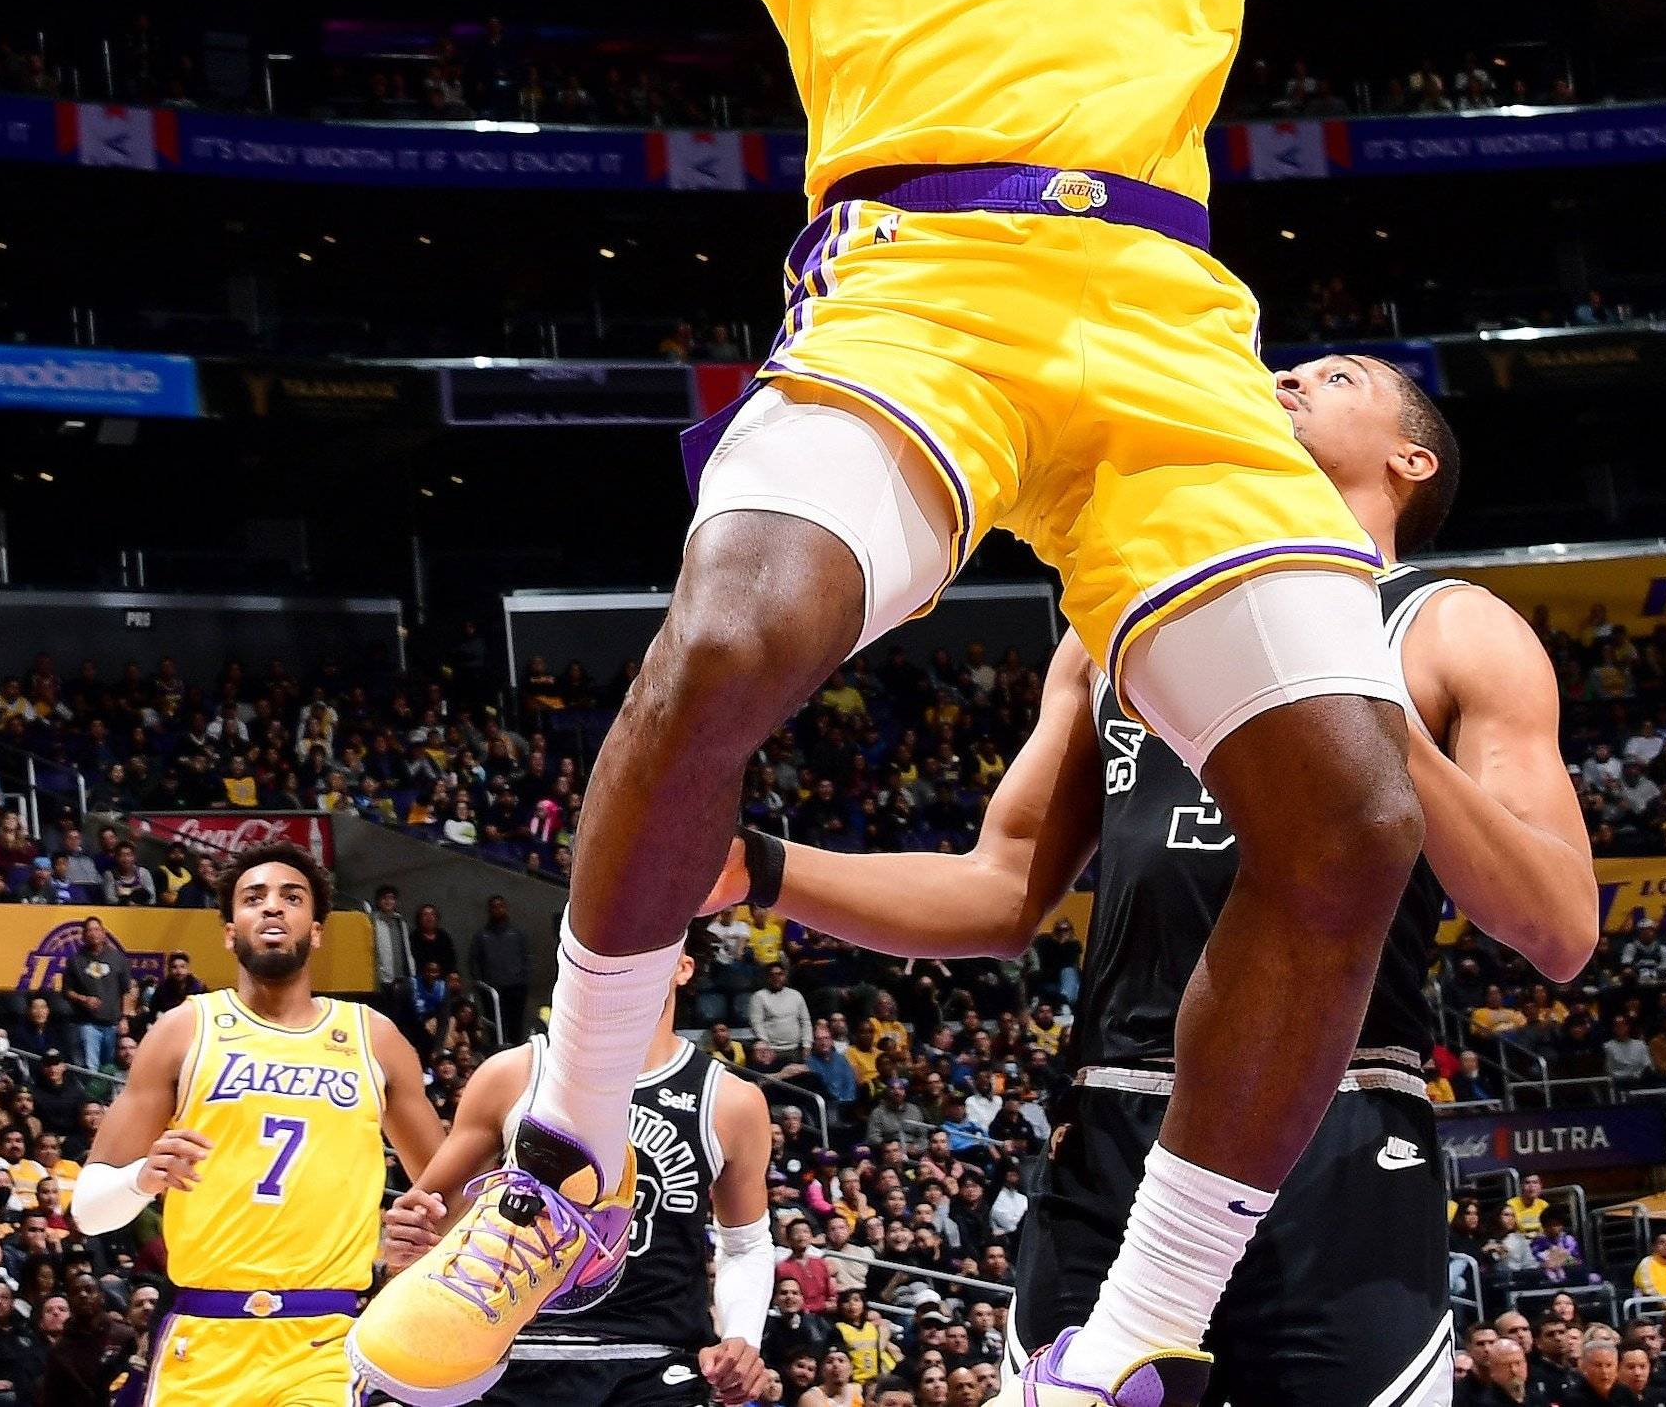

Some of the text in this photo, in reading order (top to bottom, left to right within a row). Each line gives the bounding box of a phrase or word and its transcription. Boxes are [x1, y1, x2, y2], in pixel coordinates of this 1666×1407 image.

[204, 1051, 361, 1109] LAKERS
[254, 1114, 309, 1203] 7
[628, 1103, 700, 1214] TONIO
[1513, 1124, 1611, 1155] ULTRA
